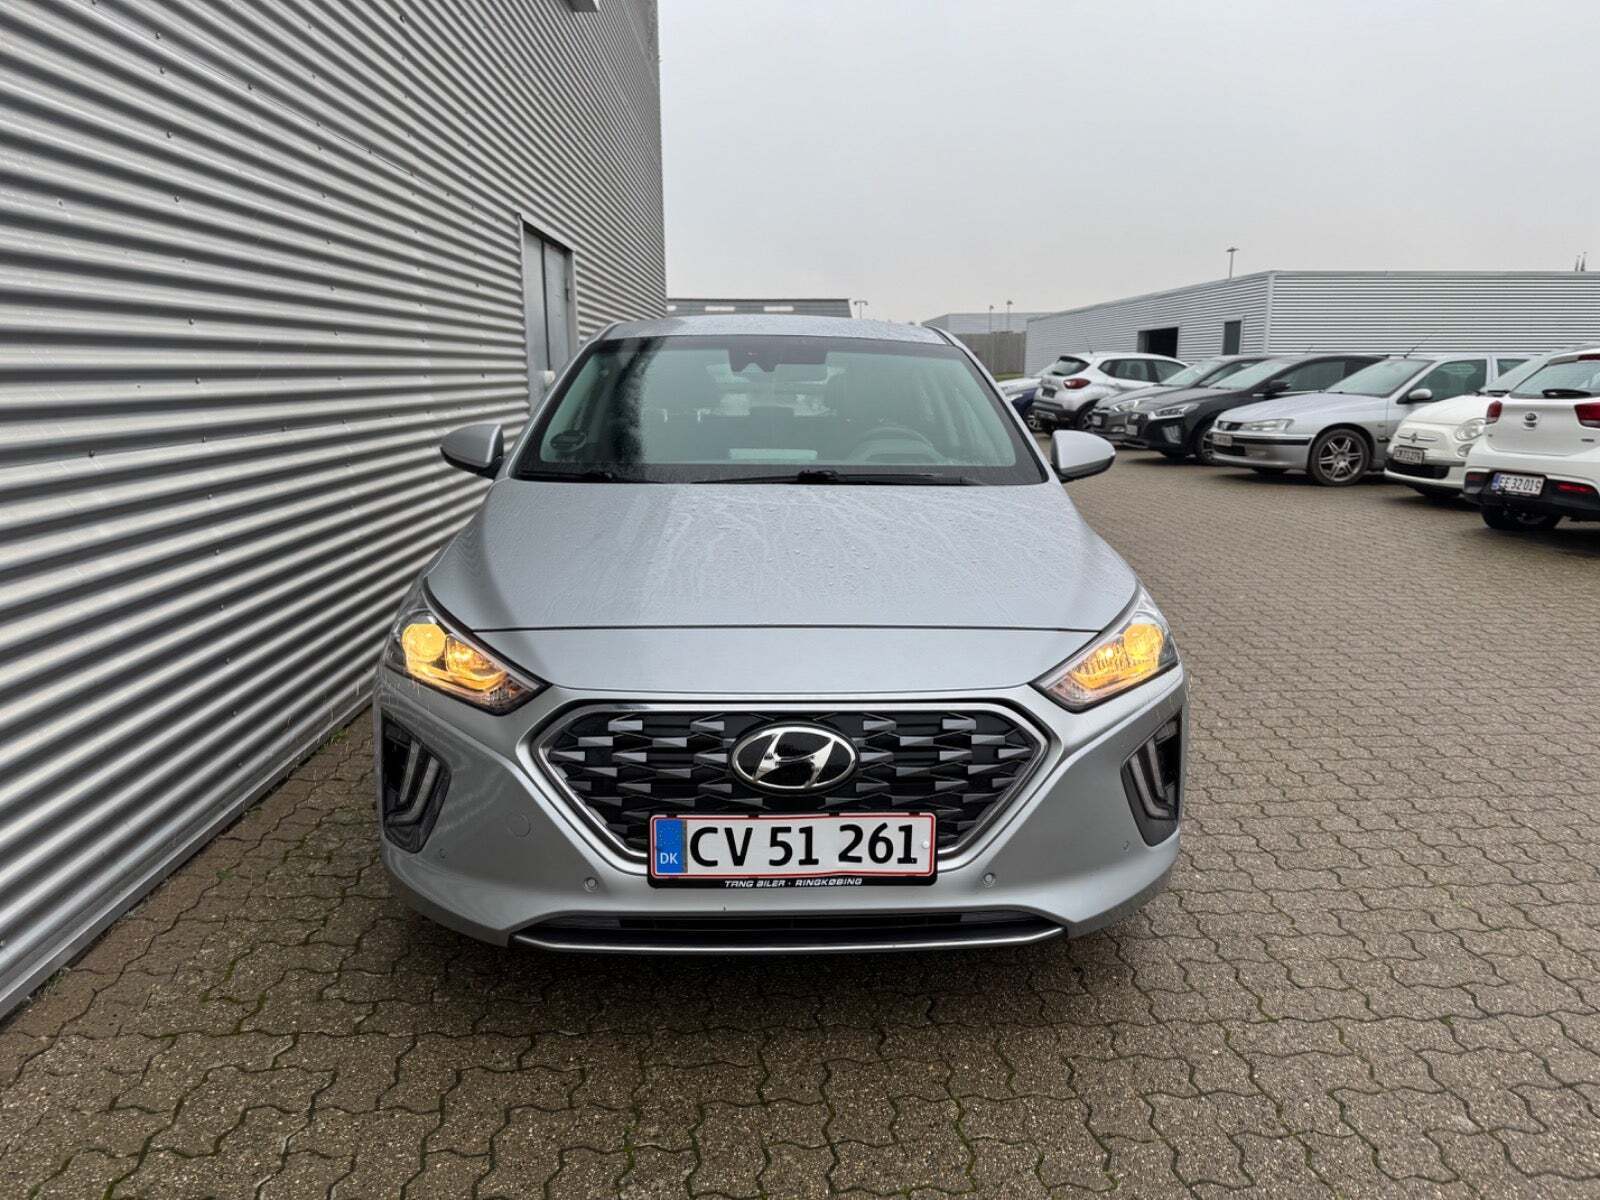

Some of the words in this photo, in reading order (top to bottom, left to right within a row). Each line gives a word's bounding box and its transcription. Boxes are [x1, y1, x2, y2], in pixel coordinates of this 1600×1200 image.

[690, 826, 753, 867] CV
[769, 826, 819, 866] 51
[838, 822, 918, 864] 261
[660, 852, 678, 865] DK
[725, 880, 754, 888] TANG
[756, 879, 786, 887] BILER
[795, 878, 863, 887] RINGKØBING
